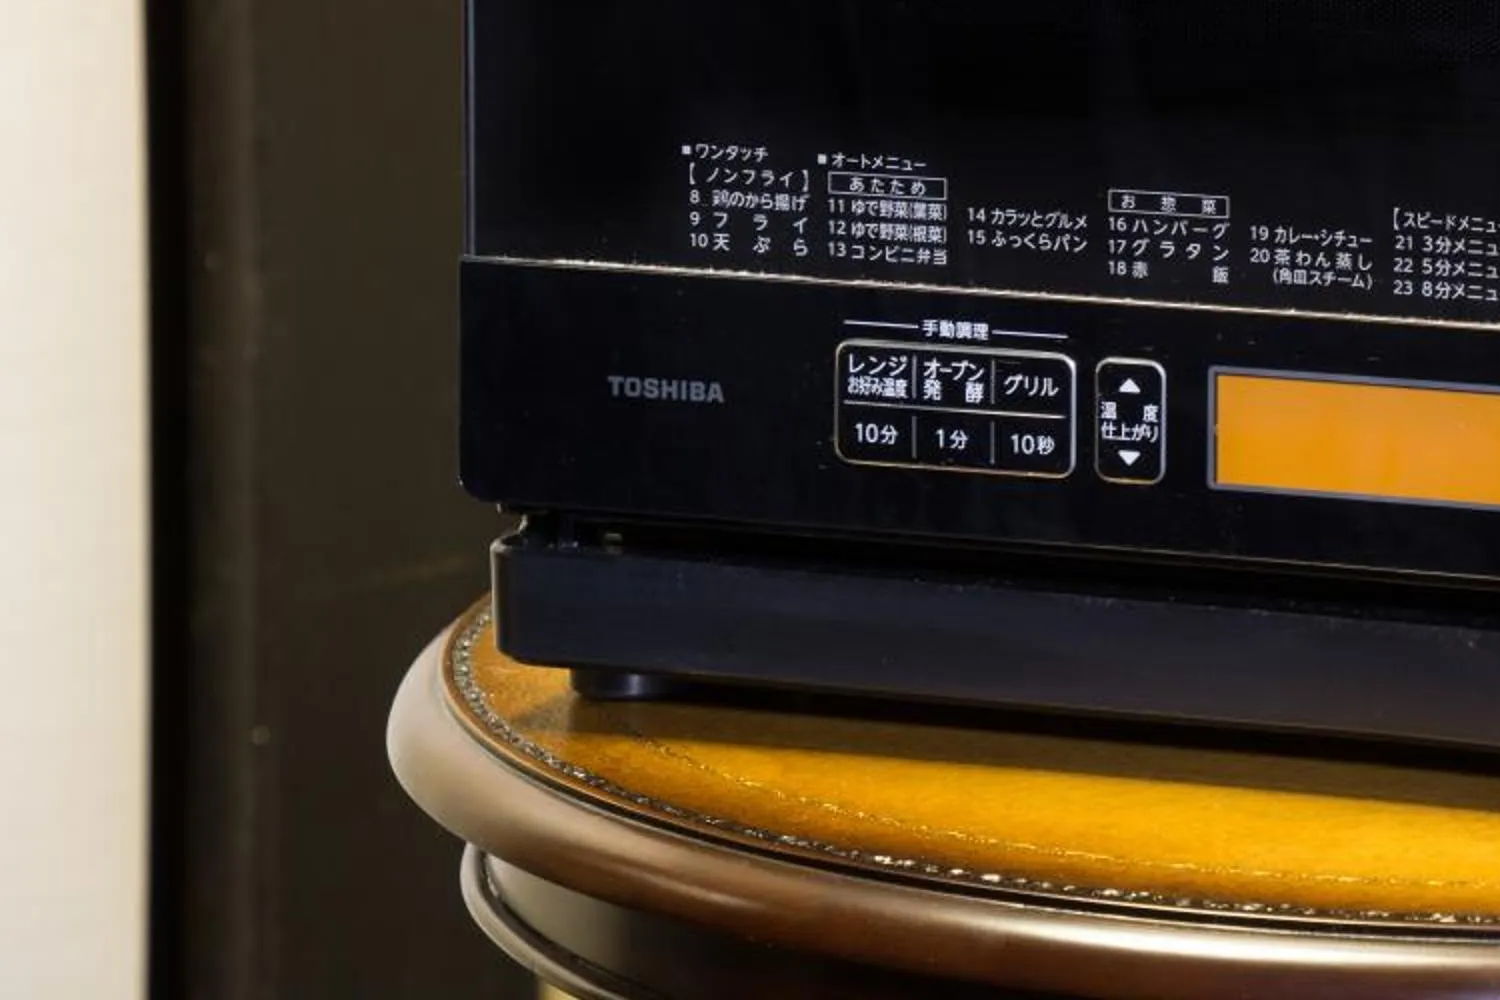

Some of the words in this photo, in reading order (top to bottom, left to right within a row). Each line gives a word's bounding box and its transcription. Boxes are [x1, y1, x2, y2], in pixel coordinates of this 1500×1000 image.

[695, 143, 769, 162] ワンタッチ
[831, 153, 927, 171] オートメニュー
[690, 189, 700, 204] 8
[849, 176, 927, 196] あたため
[828, 198, 845, 213] 11
[690, 211, 700, 226] 9
[828, 220, 847, 236] 12
[967, 207, 986, 222] 14
[991, 208, 1088, 230] カラッとグルメ
[1108, 216, 1127, 232] 16
[1132, 218, 1231, 239] ハンバーグ
[690, 233, 709, 248] 10
[967, 229, 986, 245] 15
[991, 231, 1088, 253] ふっくらパン
[1250, 225, 1269, 241] 19
[1395, 235, 1413, 251] 21
[828, 241, 847, 257] 13
[851, 245, 947, 265] コンビニ弁当
[1108, 239, 1126, 254] 17
[1132, 238, 1229, 262] グラタン
[1250, 247, 1271, 263] 20
[1273, 248, 1373, 271] 茶わん蒸し
[1108, 260, 1127, 276] 18
[1393, 257, 1413, 273] 22
[1393, 279, 1413, 295] 23
[922, 319, 989, 341] 手動調理
[849, 353, 908, 377] レンジ
[923, 357, 985, 381] オーブン
[607, 375, 725, 404] TOSHIBA
[1003, 374, 1060, 397] グリル
[854, 422, 899, 446] 10分
[936, 427, 968, 450] 1分
[1101, 421, 1160, 445] 仕上がり
[1010, 433, 1056, 456] 10秒
